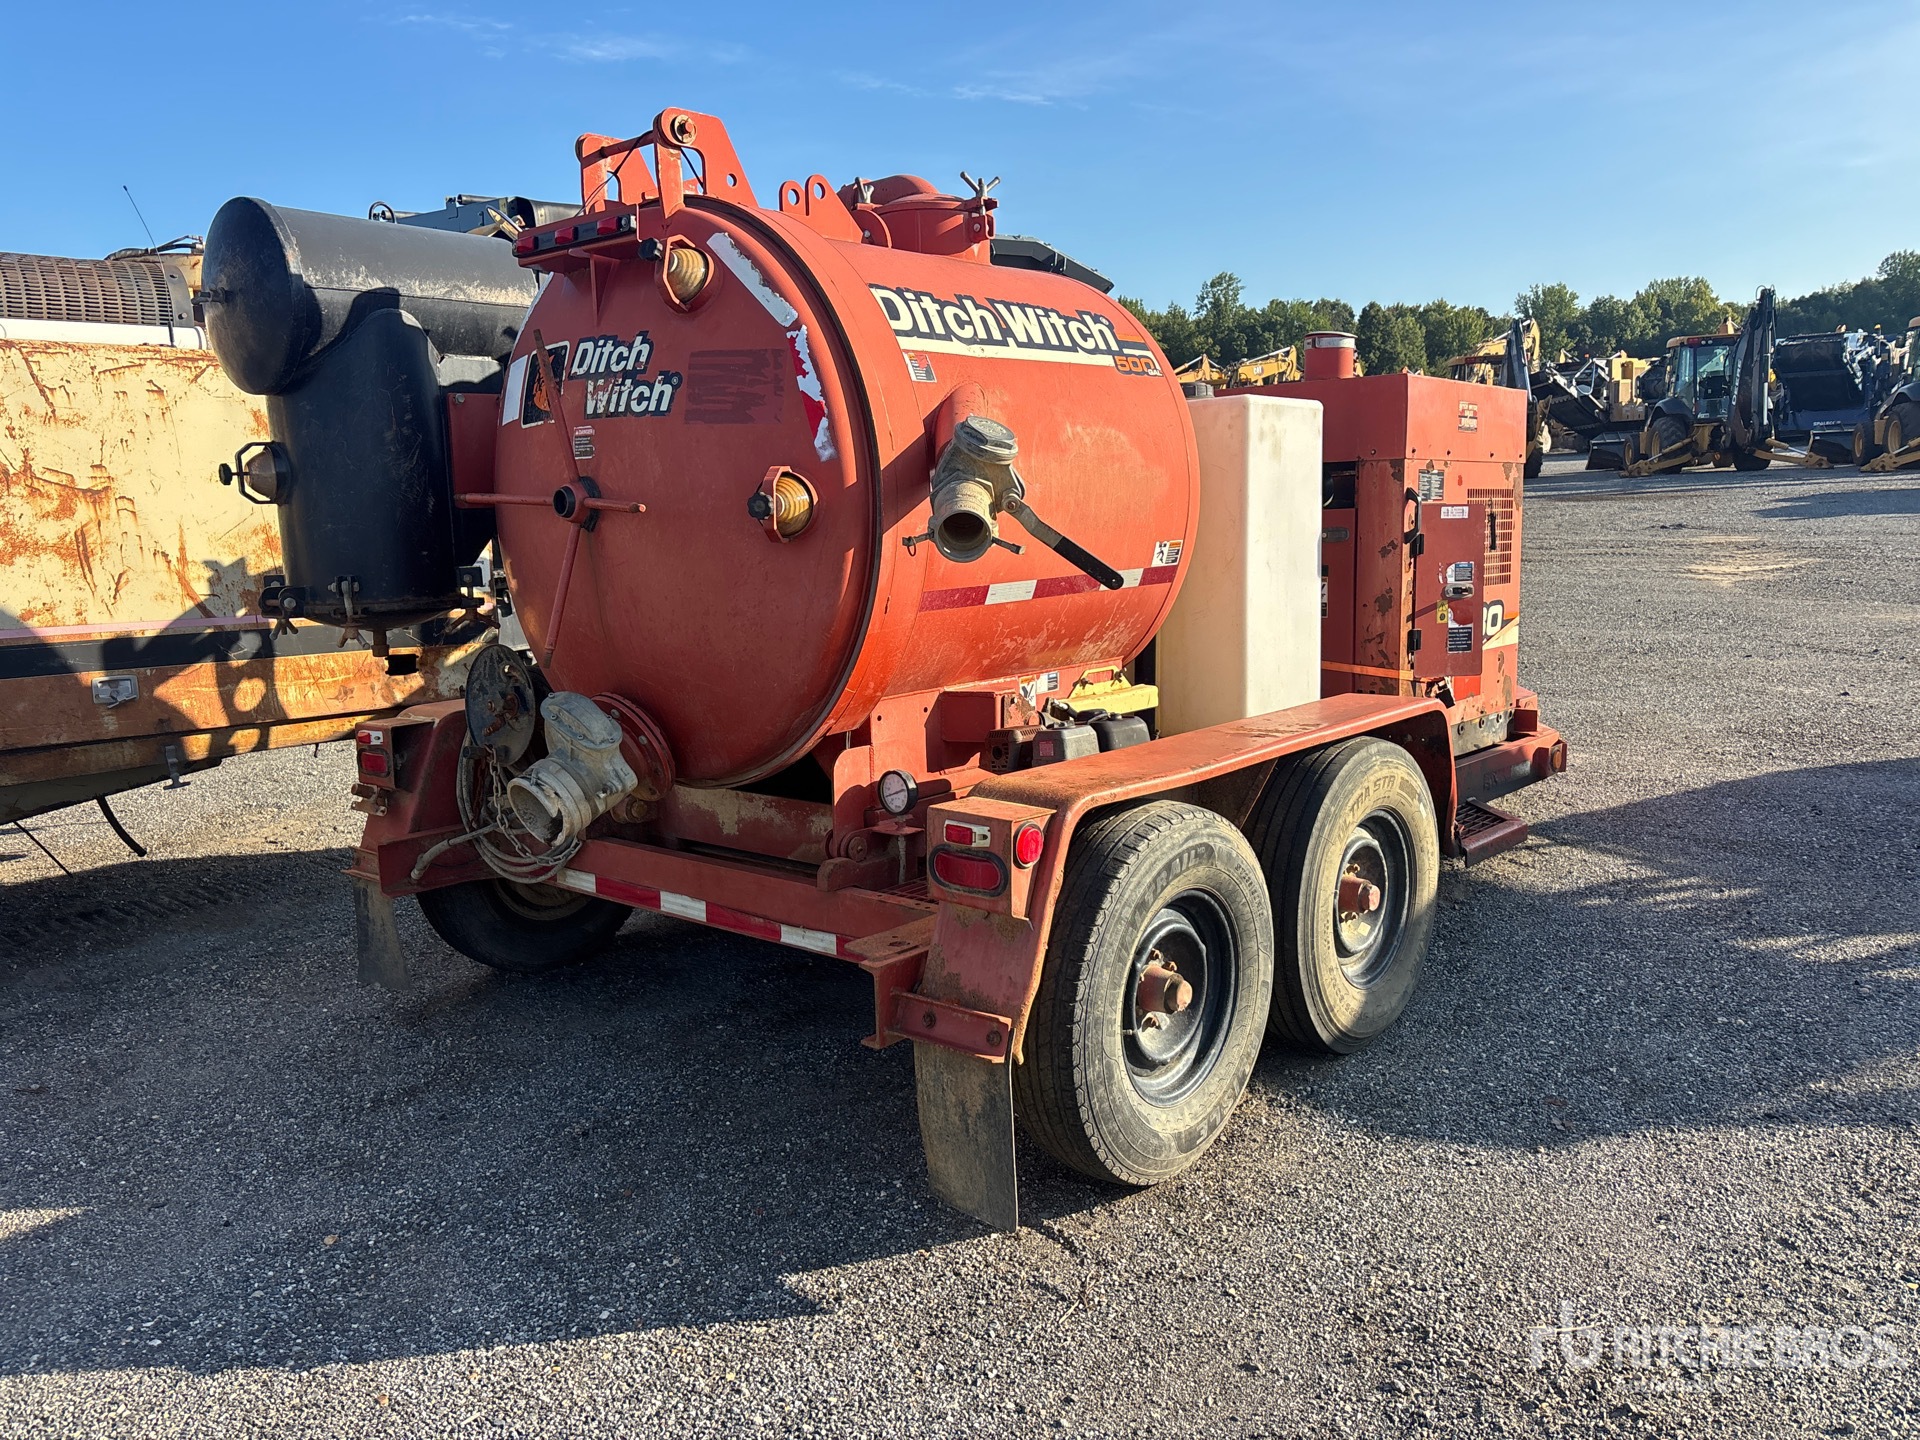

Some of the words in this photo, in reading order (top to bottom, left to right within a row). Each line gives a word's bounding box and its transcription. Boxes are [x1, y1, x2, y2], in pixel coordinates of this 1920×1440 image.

[870, 288, 1001, 341] Ditch
[993, 301, 1119, 351] Witch
[571, 335, 650, 376] Ditch
[1114, 355, 1155, 373] 500
[586, 375, 673, 415] Witch
